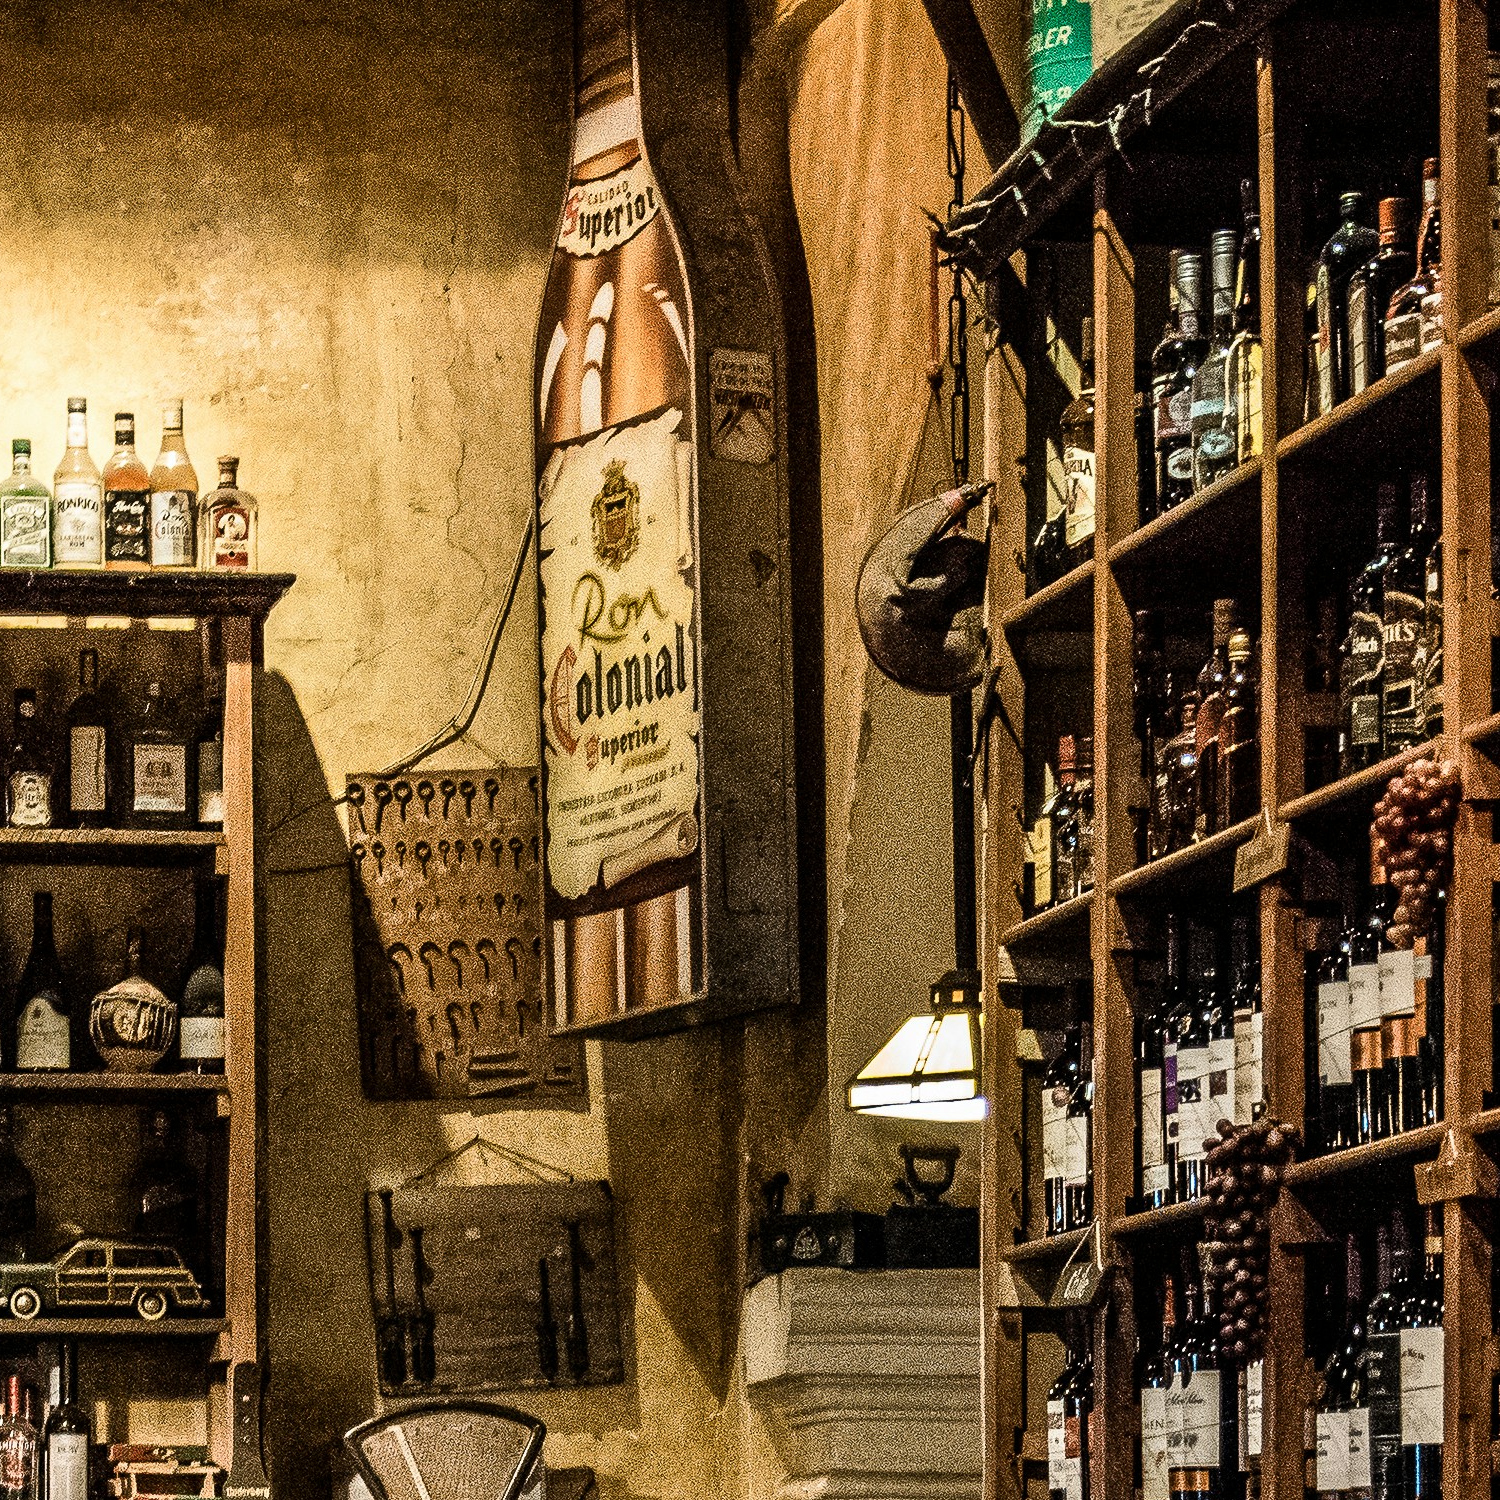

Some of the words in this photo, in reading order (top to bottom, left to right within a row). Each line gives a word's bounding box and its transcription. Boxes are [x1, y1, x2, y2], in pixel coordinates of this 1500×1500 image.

[571, 570, 668, 651] Ron
[550, 622, 687, 757] Colonial
[585, 718, 659, 771] Superior
